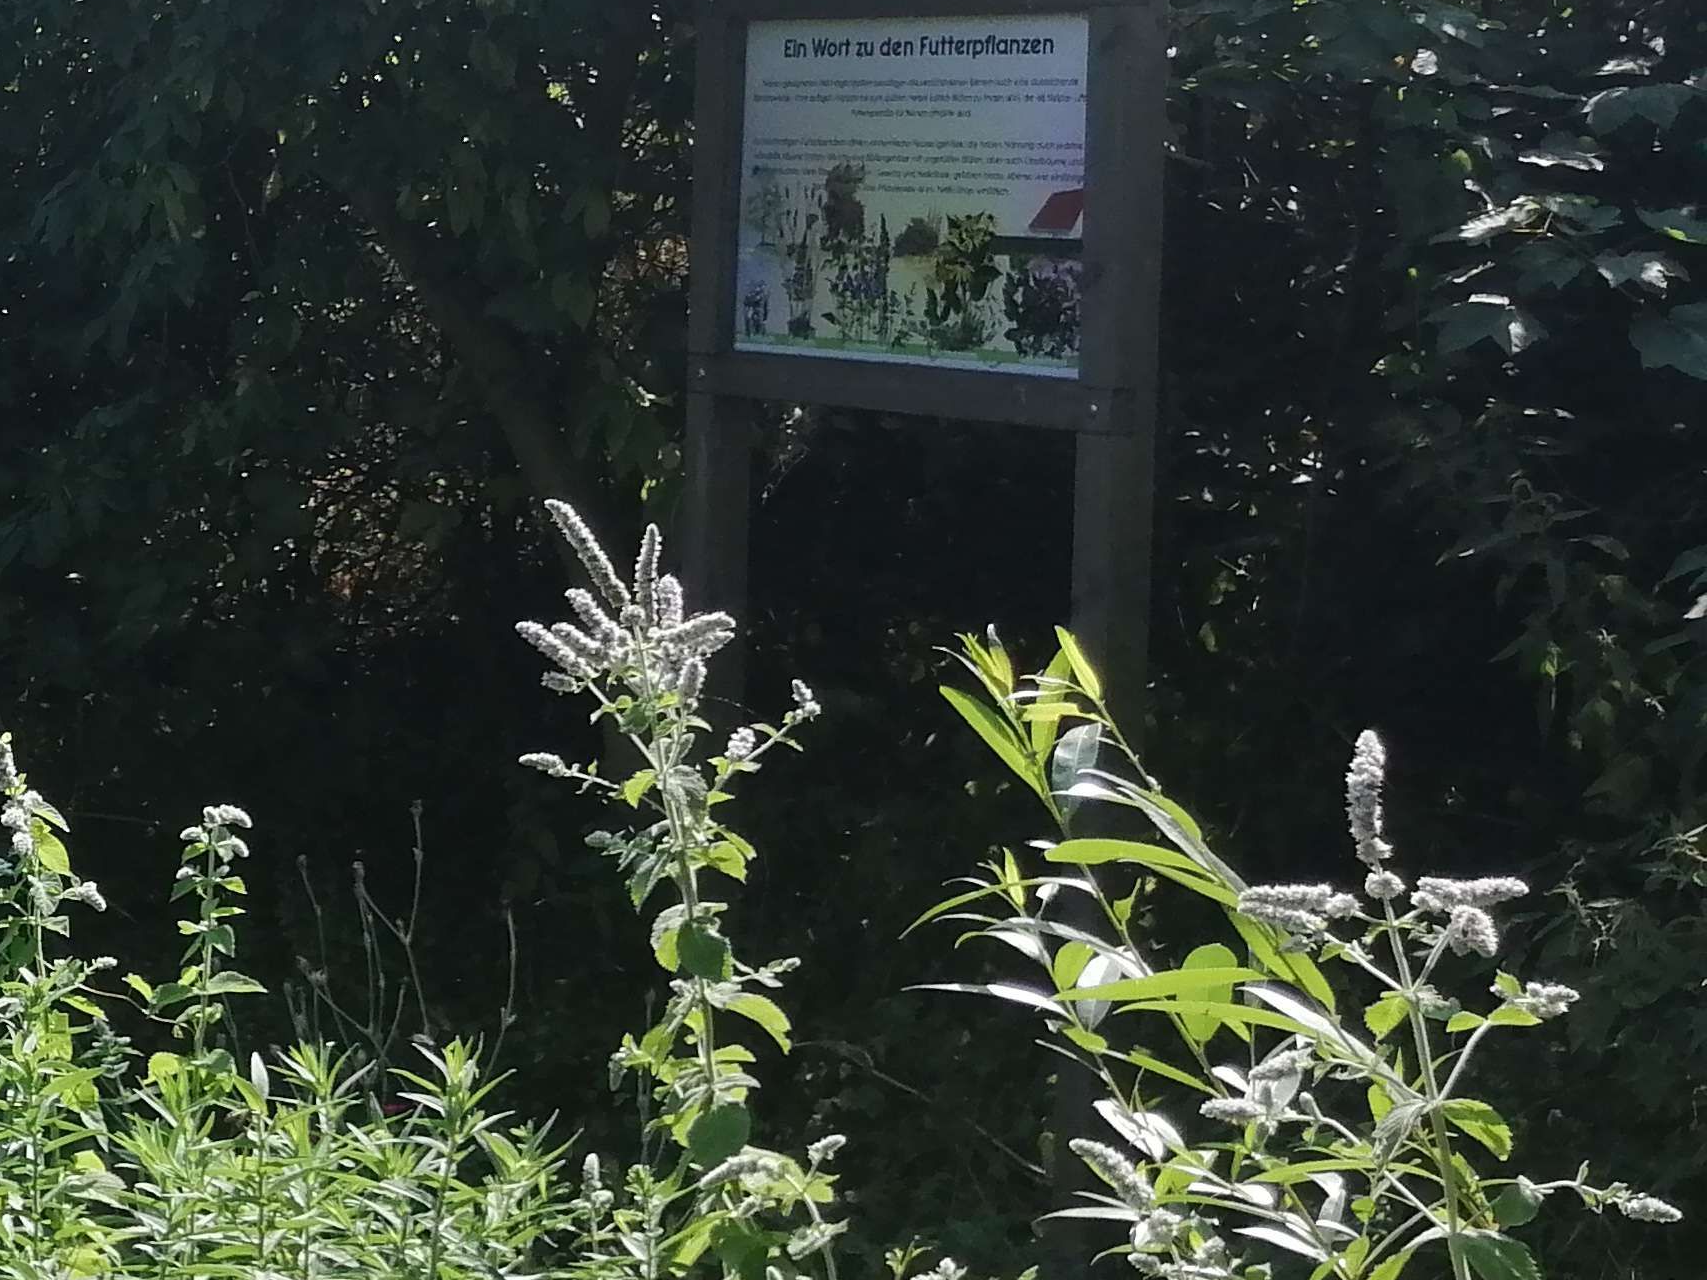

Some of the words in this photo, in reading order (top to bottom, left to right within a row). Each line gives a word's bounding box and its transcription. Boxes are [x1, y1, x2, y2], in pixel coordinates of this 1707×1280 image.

[784, 39, 806, 58] Ein
[812, 38, 850, 58] Wort
[855, 43, 874, 58] zu
[879, 37, 914, 57] den
[920, 35, 1055, 59] Futterpflanzen
